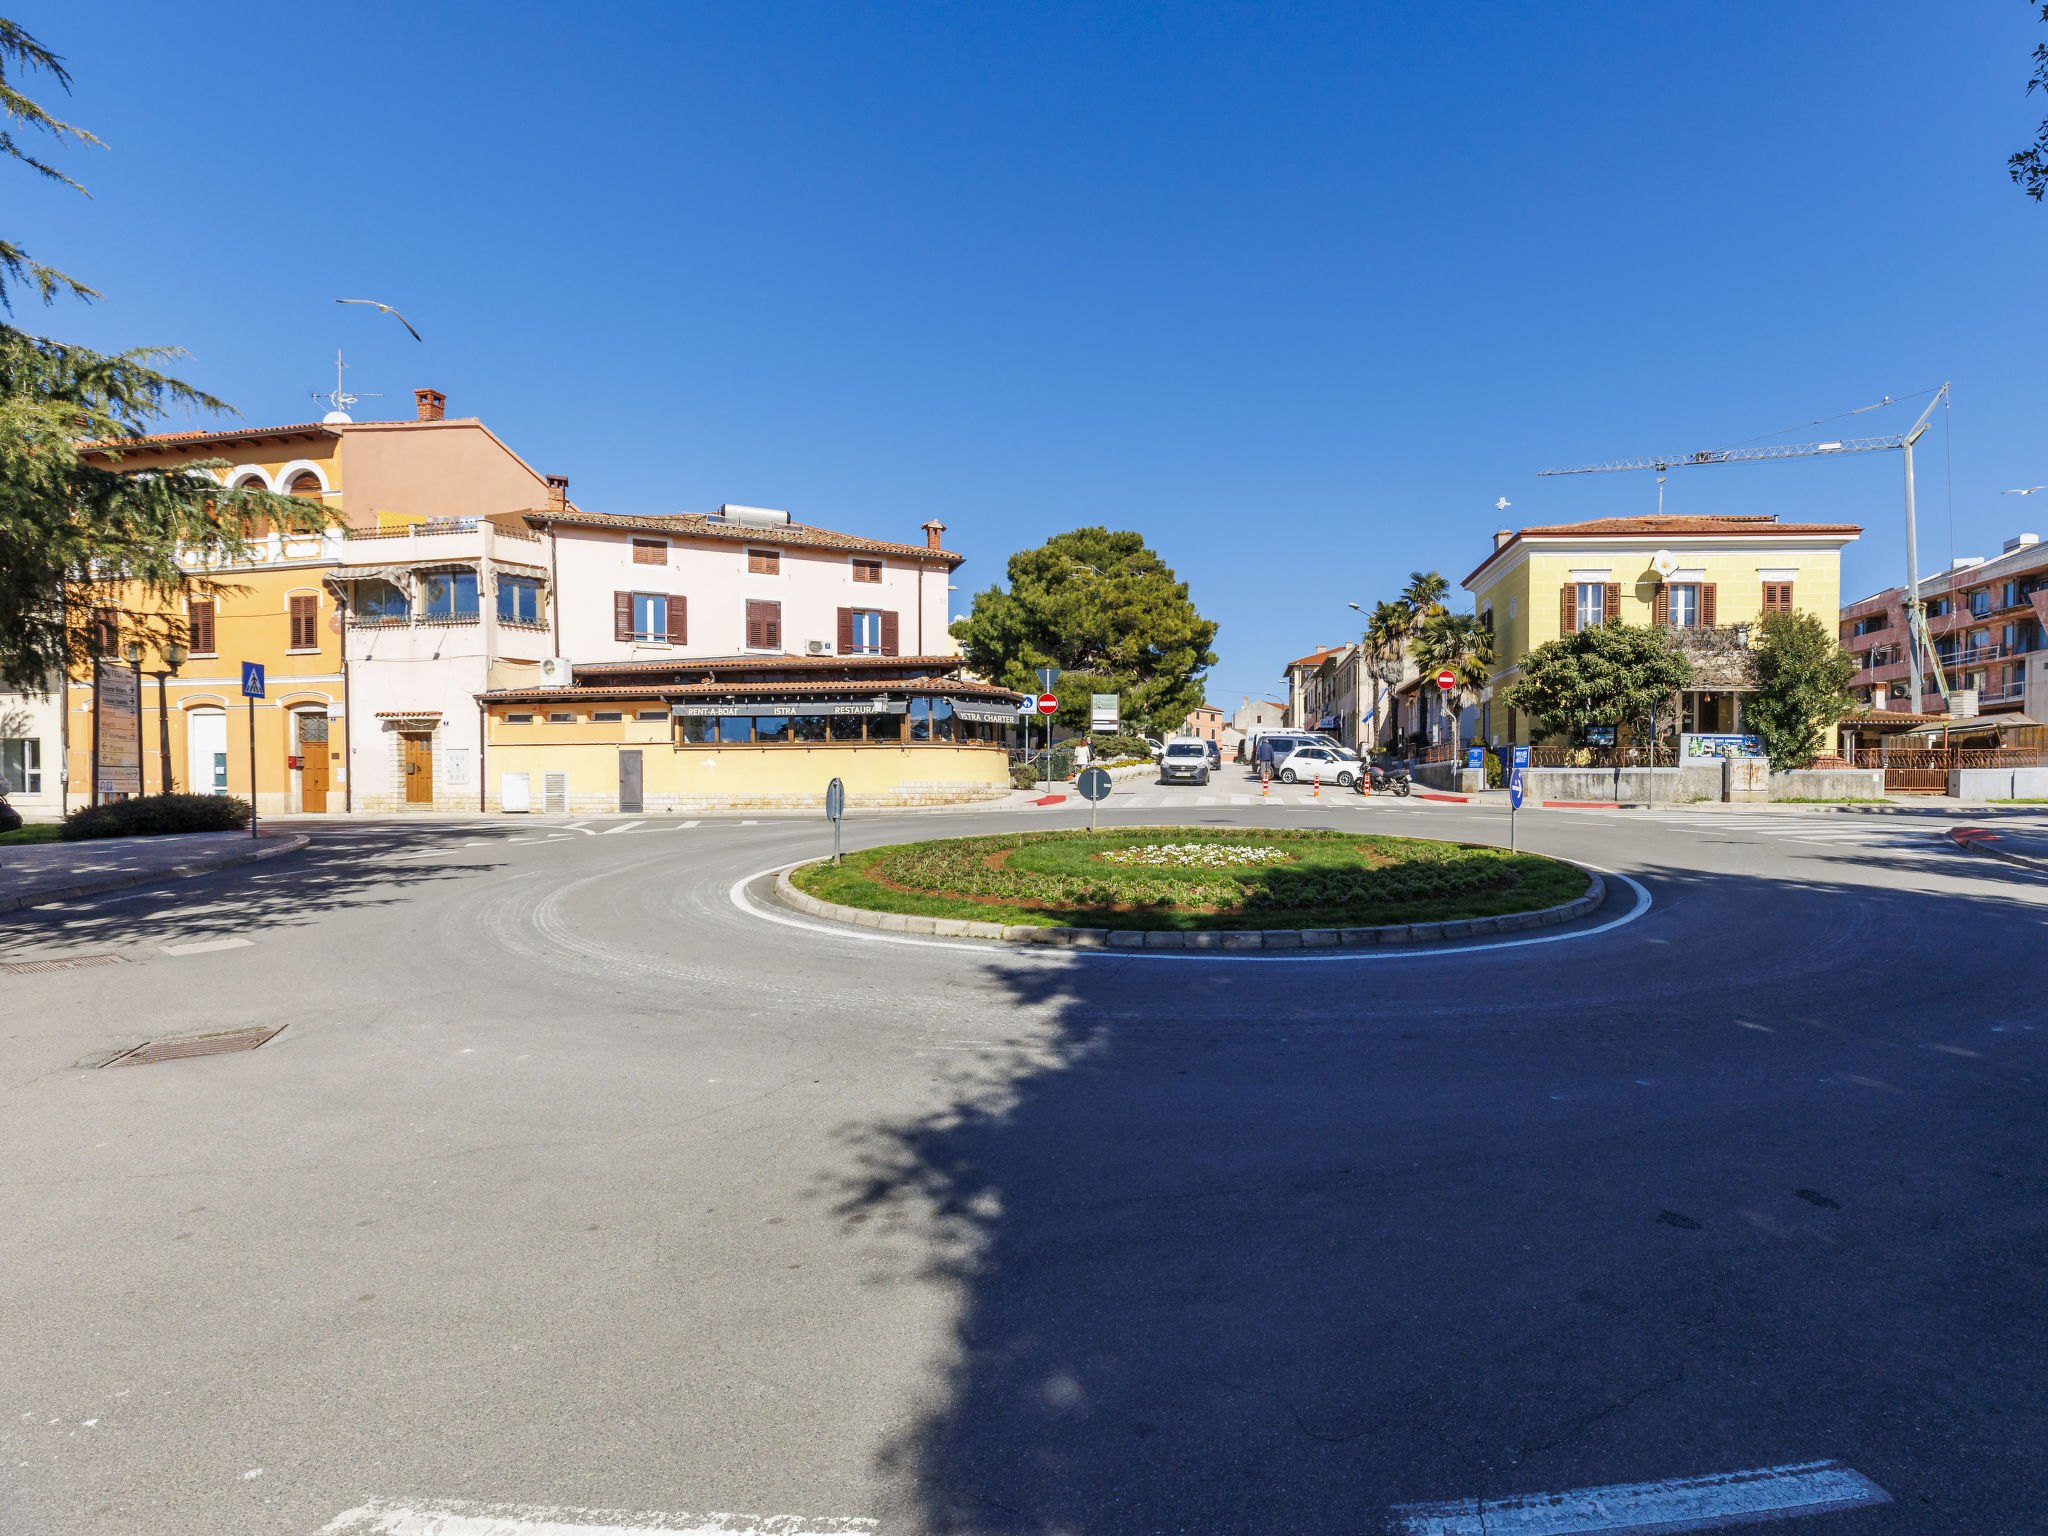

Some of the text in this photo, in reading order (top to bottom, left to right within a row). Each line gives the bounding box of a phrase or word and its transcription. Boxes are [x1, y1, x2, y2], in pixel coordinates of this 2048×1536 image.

[688, 707, 739, 716] RENT-A-BOAT
[774, 707, 797, 715] ISTRA
[960, 712, 1015, 724] ISTRA CHARTER
